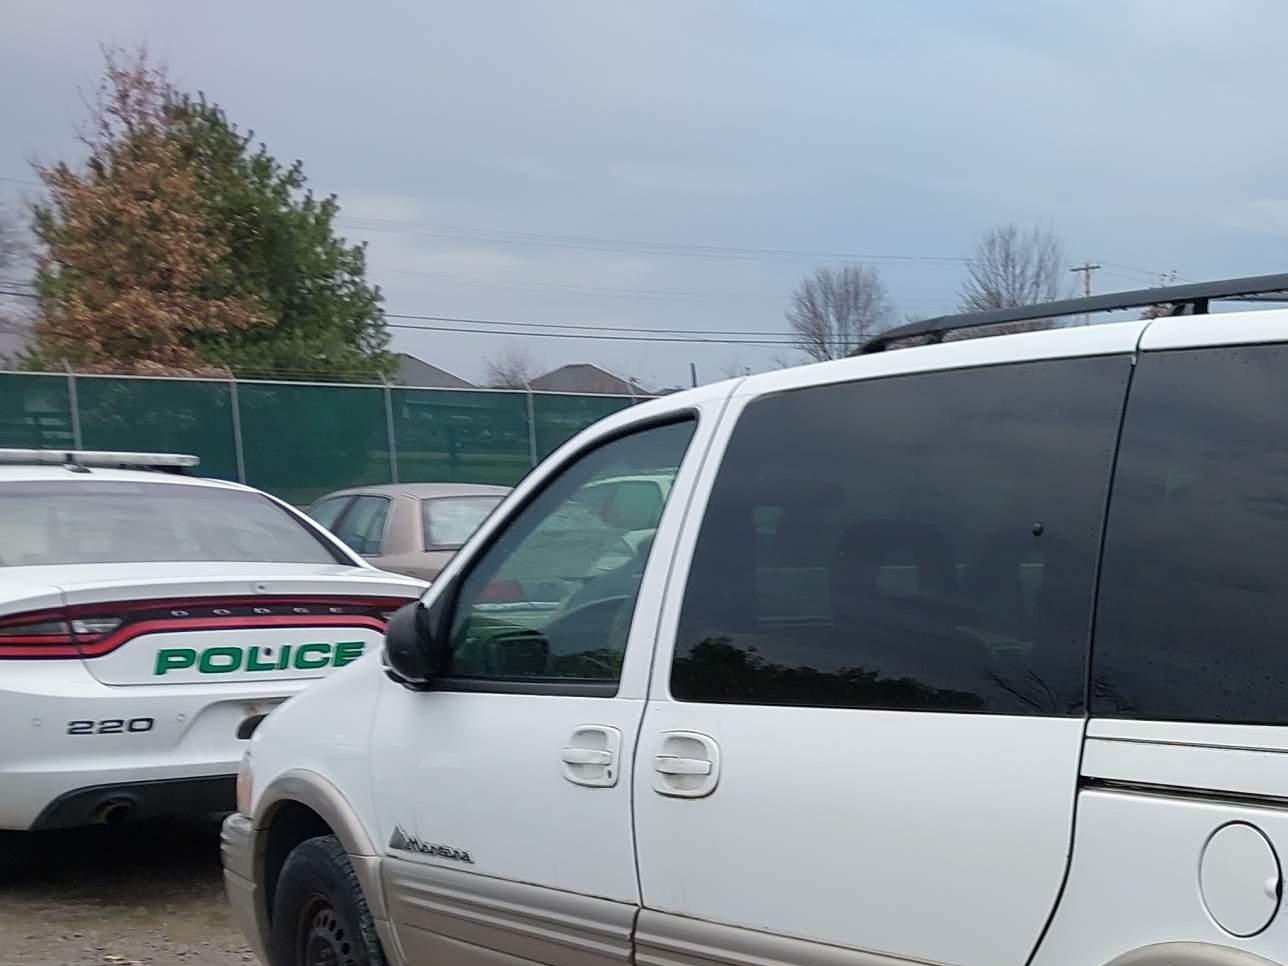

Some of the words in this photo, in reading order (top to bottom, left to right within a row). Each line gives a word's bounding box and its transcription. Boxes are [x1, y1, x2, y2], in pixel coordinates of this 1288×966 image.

[170, 605, 345, 617] DODGE
[154, 641, 366, 676] POLICE
[66, 717, 155, 736] 220
